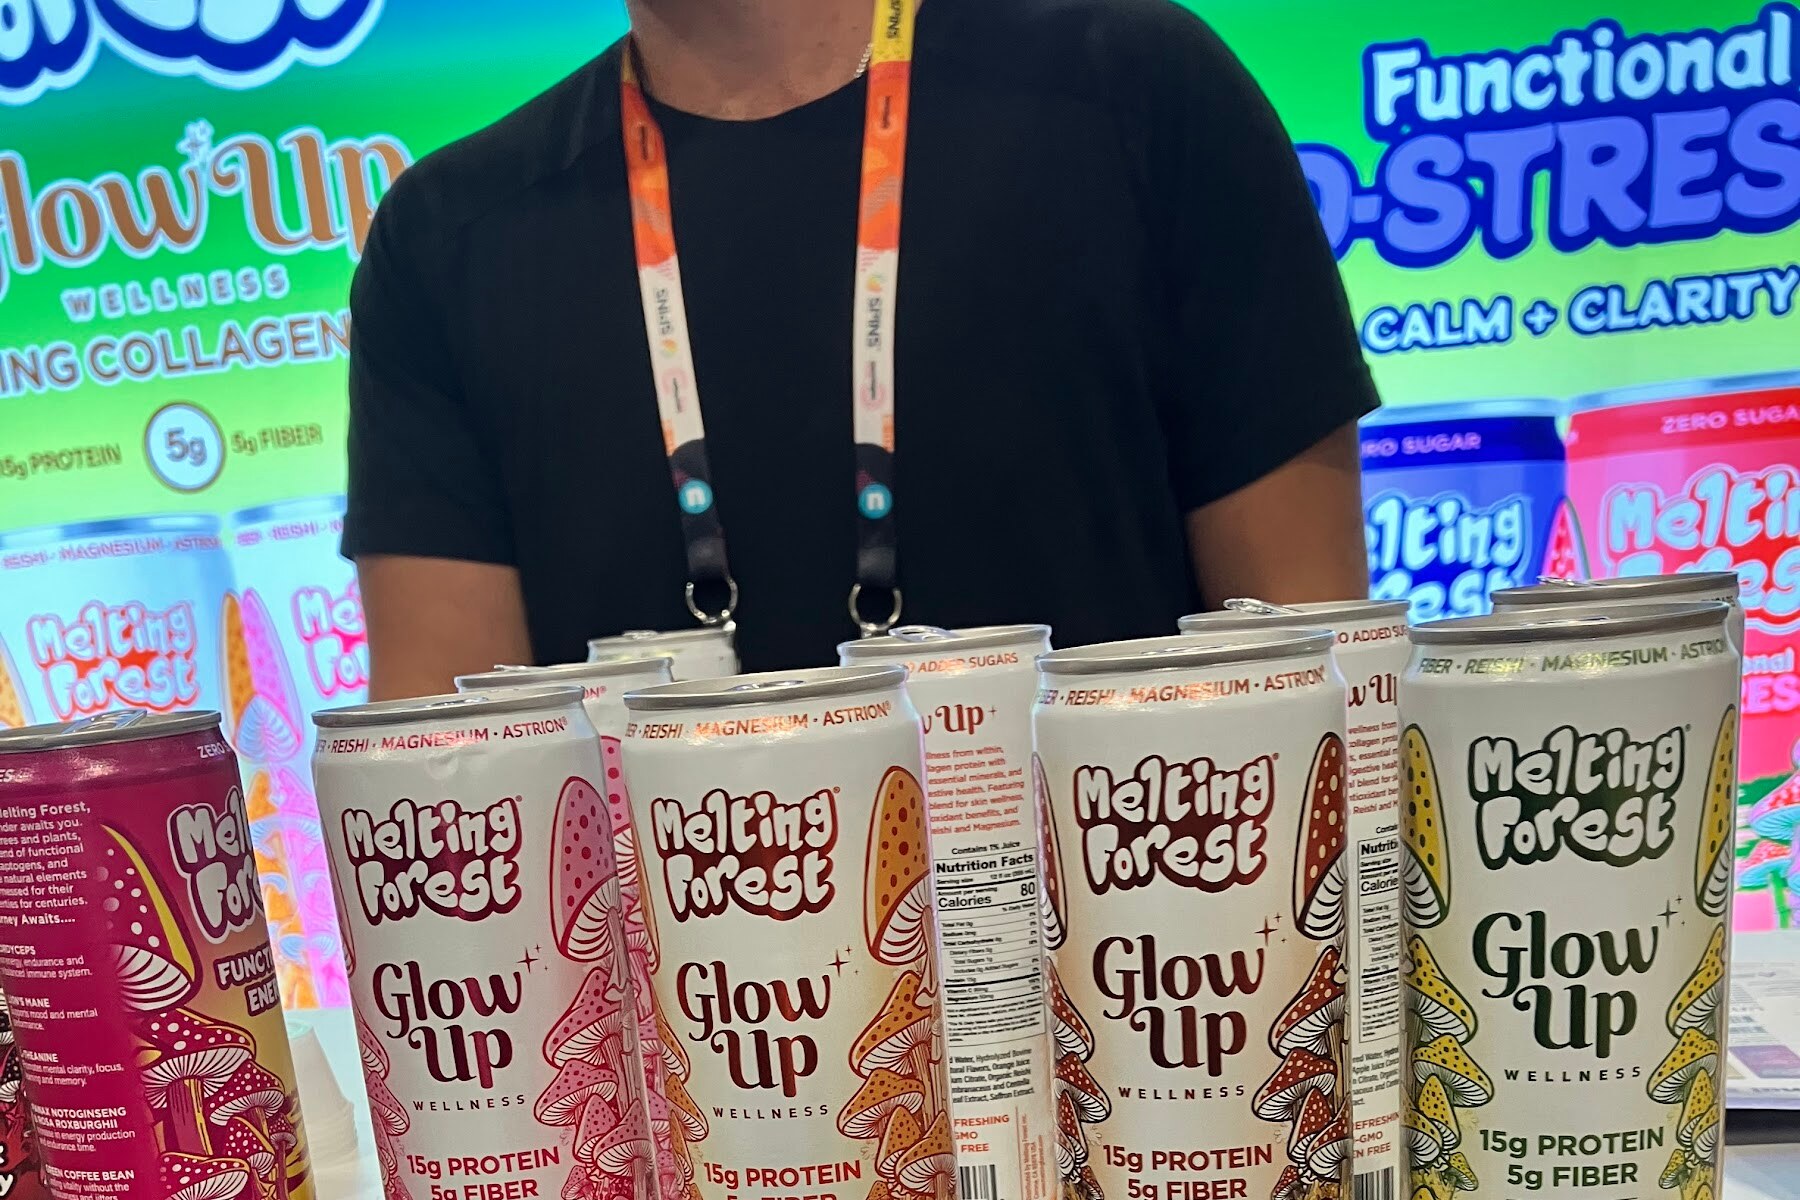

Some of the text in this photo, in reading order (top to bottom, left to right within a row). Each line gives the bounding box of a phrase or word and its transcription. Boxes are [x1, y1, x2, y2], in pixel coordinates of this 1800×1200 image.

[1371, 9, 1792, 126] Functional
[0, 155, 203, 270] low
[64, 266, 288, 320] WELLNESS
[1364, 268, 1800, 352] CALM + CLARITY
[86, 313, 350, 382] COLLAGEN
[1660, 411, 1727, 436] ZERO
[166, 427, 208, 466] 5g
[231, 423, 323, 456] 5g FIBER
[1400, 431, 1482, 456] SUGAR
[30, 444, 122, 473] PROTEIN
[28, 601, 198, 668] Melting
[969, 652, 1018, 668] SUGARS
[1541, 646, 1667, 673] MAGNESIUM
[43, 655, 199, 721] Forest
[1129, 678, 1250, 704] MAGNESIUM
[642, 722, 683, 739] REISHI
[695, 713, 808, 738] MAGNESIUM
[935, 704, 984, 736] Up
[331, 738, 368, 754] REISHI
[381, 727, 489, 751] MAGNESIUM
[1468, 724, 1686, 800] Melting
[1074, 755, 1275, 828] Melting
[40, 801, 91, 817] Forest,
[651, 788, 838, 857] Melting
[20, 818, 83, 832] awaits you.
[21, 831, 82, 845] and plants,
[342, 798, 522, 862] Melting
[1475, 796, 1677, 871] Forest
[28, 843, 84, 857] functional
[47, 858, 69, 869] and
[936, 853, 1034, 874] Nutrition Facts
[1083, 819, 1268, 895] Forest
[31, 883, 74, 896] for their
[36, 871, 87, 883] elements
[356, 854, 522, 926] Forest
[663, 850, 836, 923] Forest
[1020, 881, 1035, 897] 80
[35, 896, 88, 909] centuries.
[938, 896, 991, 909] Calories
[66, 955, 84, 966] and
[1472, 910, 1660, 999] Glow
[1092, 934, 1265, 1020] Glow
[372, 960, 522, 1039] Glow
[676, 960, 831, 1042] Glow
[1513, 984, 1637, 1059] Up
[1129, 1005, 1247, 1077] Up
[409, 1025, 513, 1089] Up
[710, 1029, 819, 1097] Up
[1504, 1066, 1641, 1083] WELLNESS
[413, 1094, 525, 1111] WELLNESS
[1118, 1085, 1245, 1100] WELLNESS
[51, 1106, 127, 1119] NOTOGINSENG
[56, 1119, 118, 1131] ROXBURGHII
[712, 1104, 828, 1119] WELLNESS
[954, 1114, 1010, 1128] FRESHING
[87, 1129, 135, 1142] production
[961, 1143, 990, 1153] FREE
[1367, 1142, 1391, 1156] FREE
[1479, 1126, 1664, 1159] 15g PROTEIN
[406, 1146, 560, 1180] 15g PROTEIN
[1103, 1143, 1272, 1173] 15g PROTEIN
[64, 1169, 134, 1181] COFFEE BEAN
[115, 1182, 129, 1193] the
[704, 1160, 861, 1190] 15g PROTEIN
[1507, 1162, 1638, 1190] 5g FIBER
[1167, 1178, 1248, 1200] FIBER
